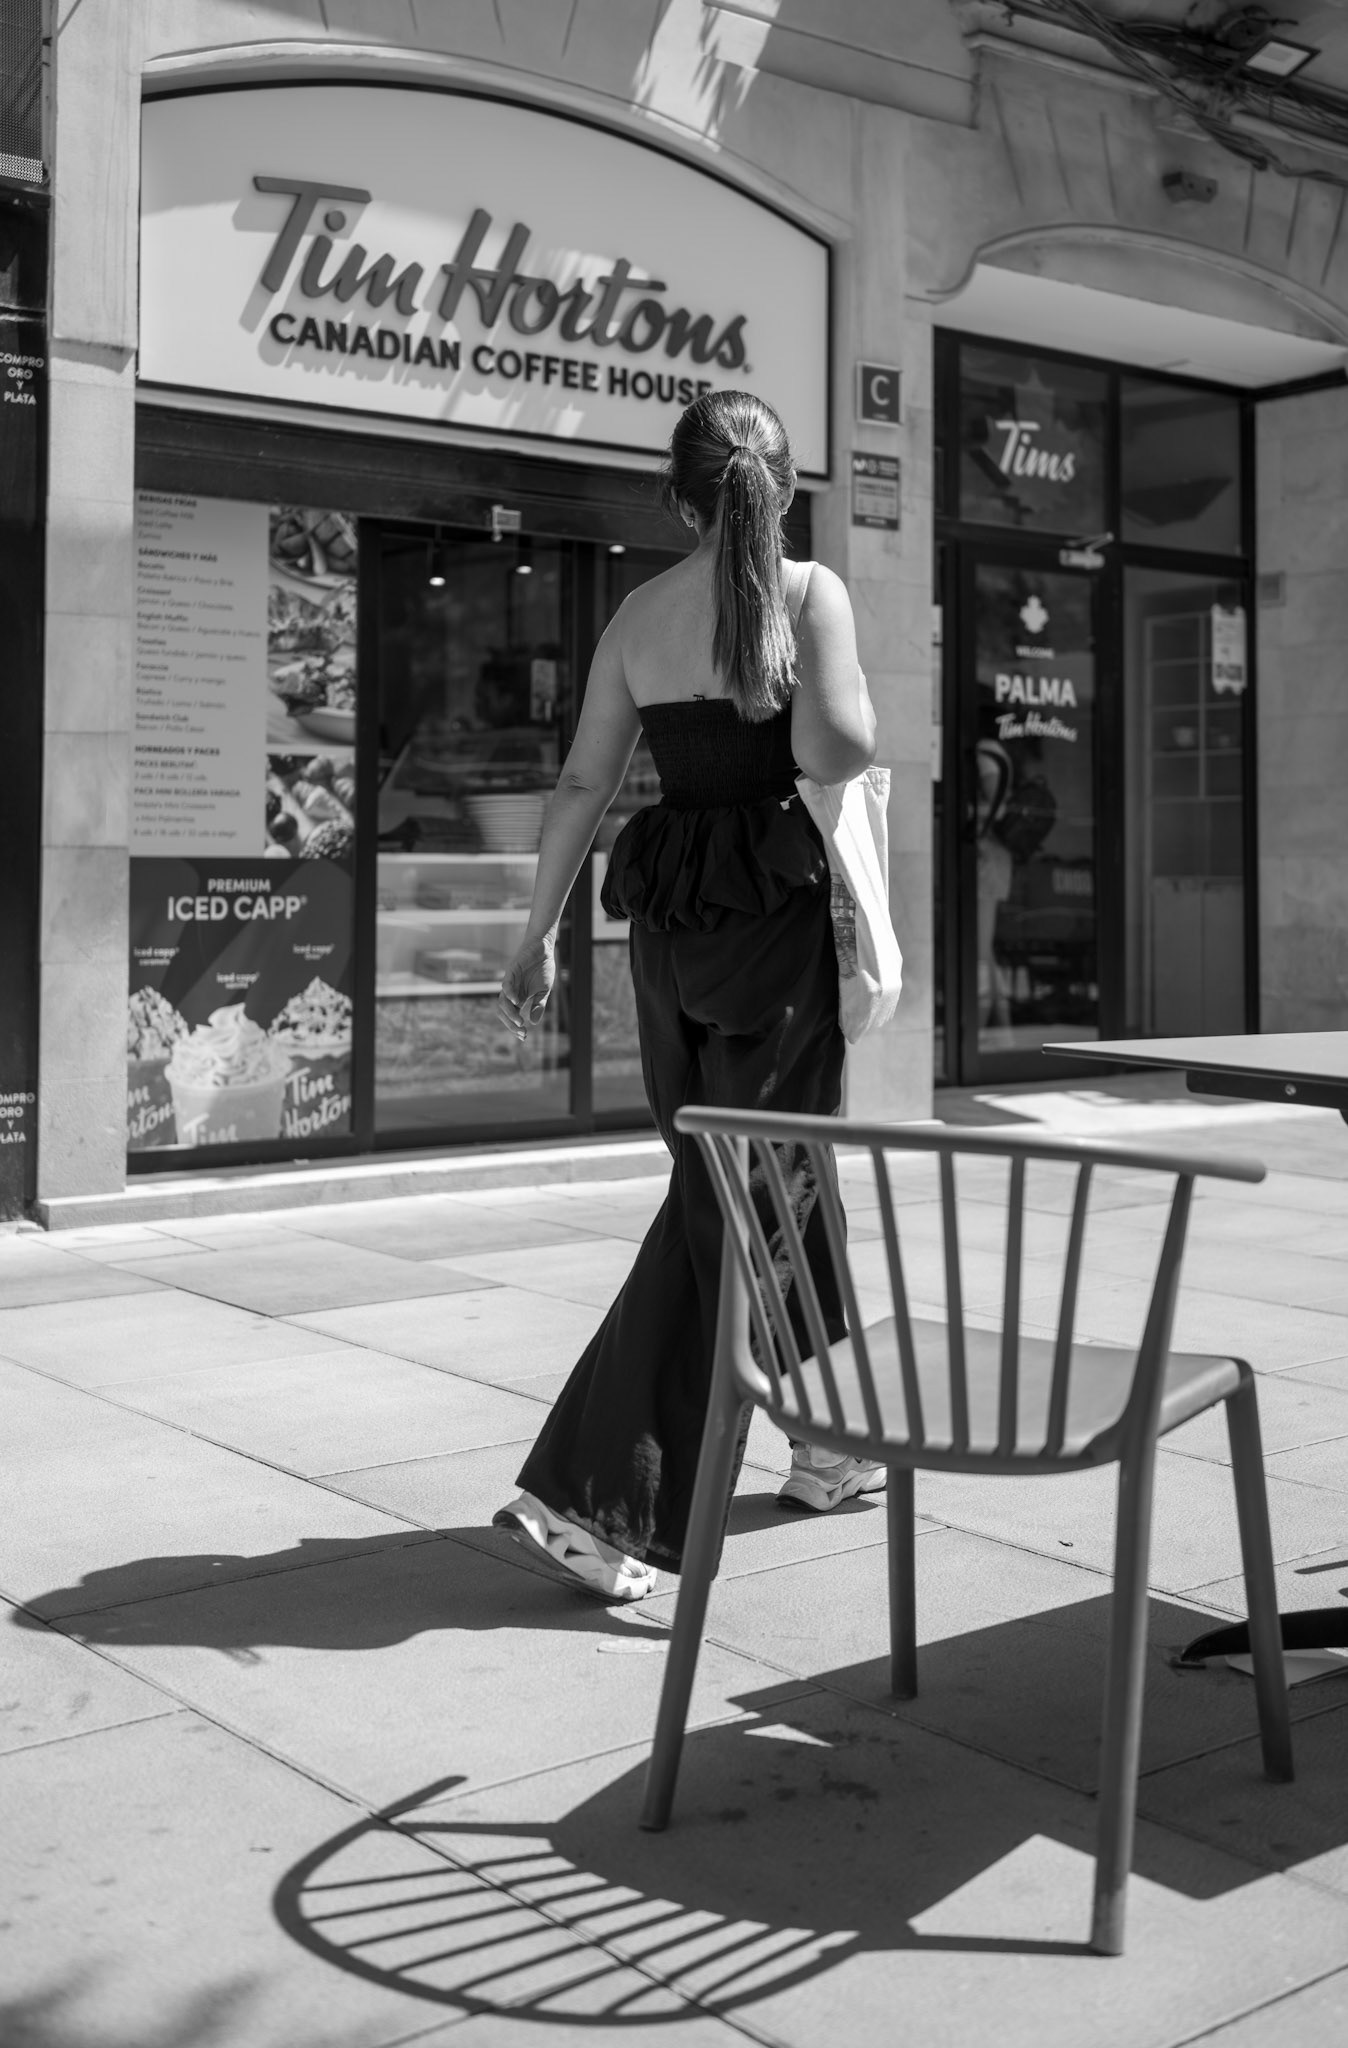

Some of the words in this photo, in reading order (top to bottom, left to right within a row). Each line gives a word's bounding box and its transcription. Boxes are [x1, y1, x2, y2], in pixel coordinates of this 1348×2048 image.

[253, 176, 424, 316] Tim
[269, 313, 461, 371] CANADIAN
[472, 345, 599, 393] COFFEE
[7, 367, 33, 379] ORO
[16, 380, 24, 390] Y
[4, 391, 37, 405] PLATA
[870, 375, 890, 405] C
[995, 420, 1076, 482] Tims
[995, 673, 1077, 708] PALMA
[995, 712, 1025, 740] Tim
[1024, 710, 1078, 742] Hortons
[207, 878, 271, 893] PREMIUM
[168, 895, 229, 921] ICED
[285, 1067, 335, 1106] Tim
[7, 1119, 14, 1130] Y
